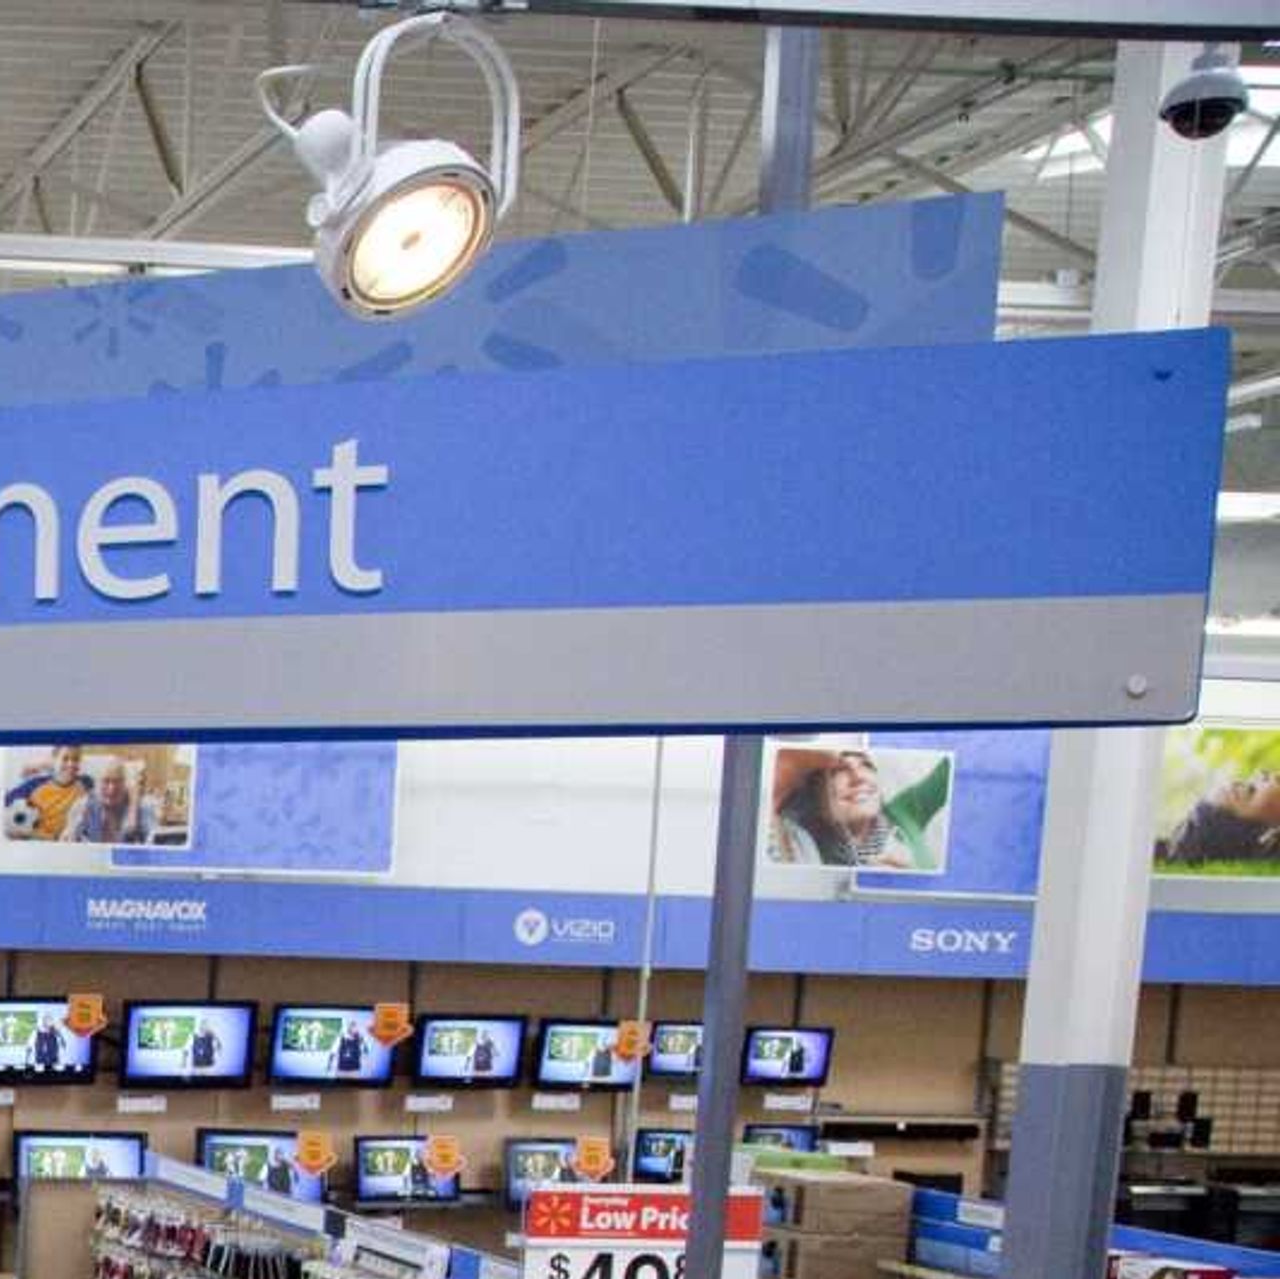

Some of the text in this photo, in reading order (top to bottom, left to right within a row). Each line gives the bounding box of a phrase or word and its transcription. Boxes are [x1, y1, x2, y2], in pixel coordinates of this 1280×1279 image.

[86, 898, 207, 920] MAGNAVOX
[909, 927, 1018, 953] SONY
[579, 1201, 689, 1231] Low Pric
